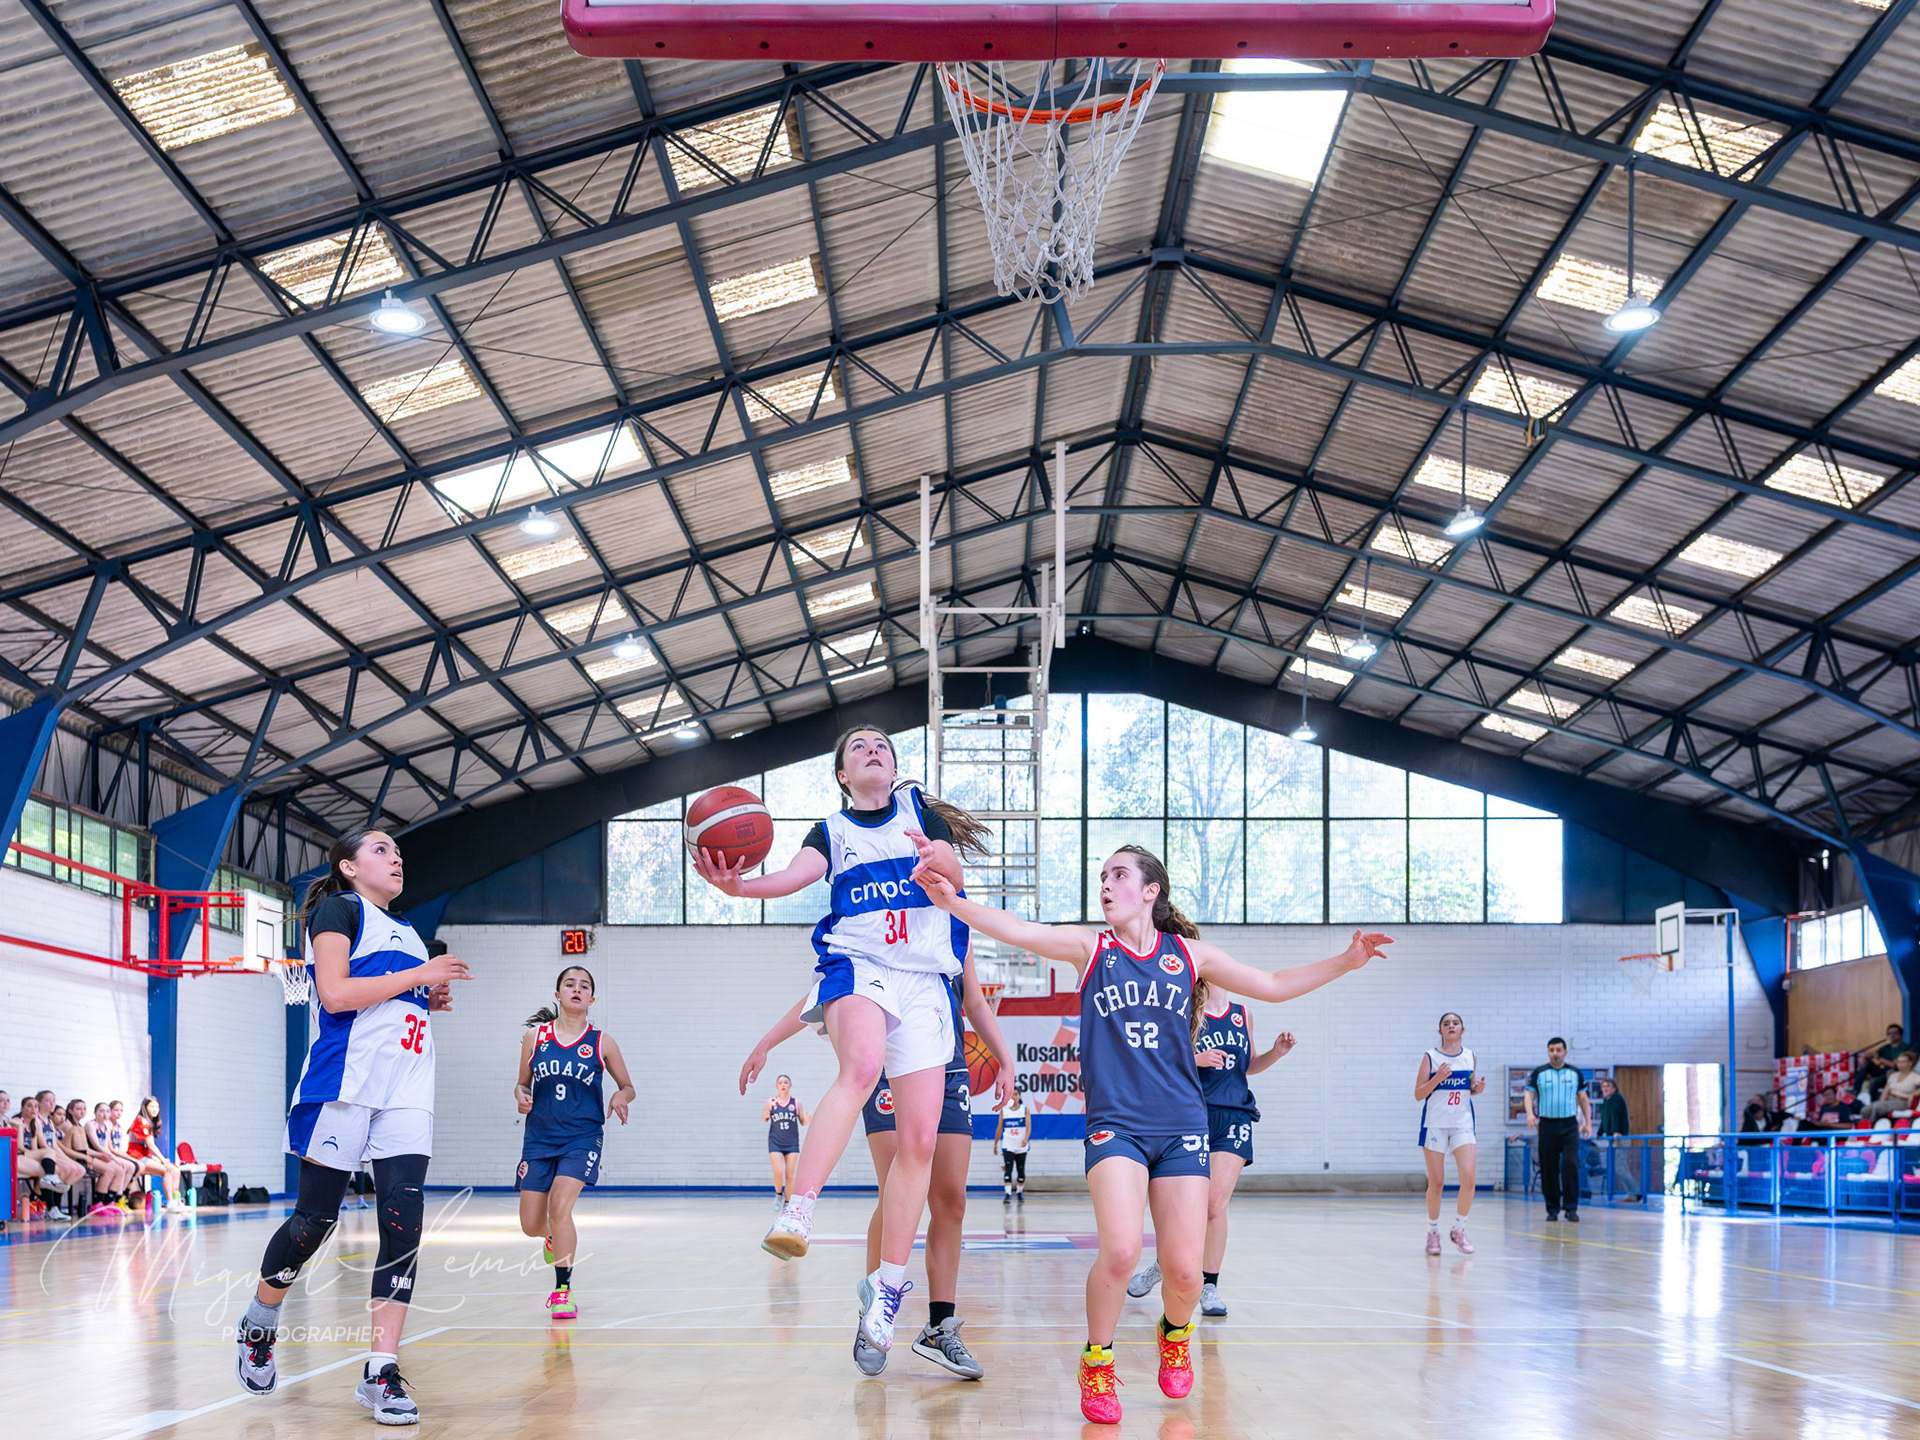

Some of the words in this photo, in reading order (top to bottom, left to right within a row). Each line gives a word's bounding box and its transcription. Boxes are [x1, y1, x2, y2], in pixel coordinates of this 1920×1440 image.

[885, 910, 908, 945] 34
[564, 931, 585, 953] 20
[1125, 1021, 1159, 1049] 52
[1216, 1053, 1236, 1070] 6
[555, 1083, 567, 1101] 9
[1447, 1091, 1461, 1105] 26
[779, 1121, 790, 1130] 15
[1226, 1123, 1251, 1143] 16
[397, 1276, 412, 1289] NBA
